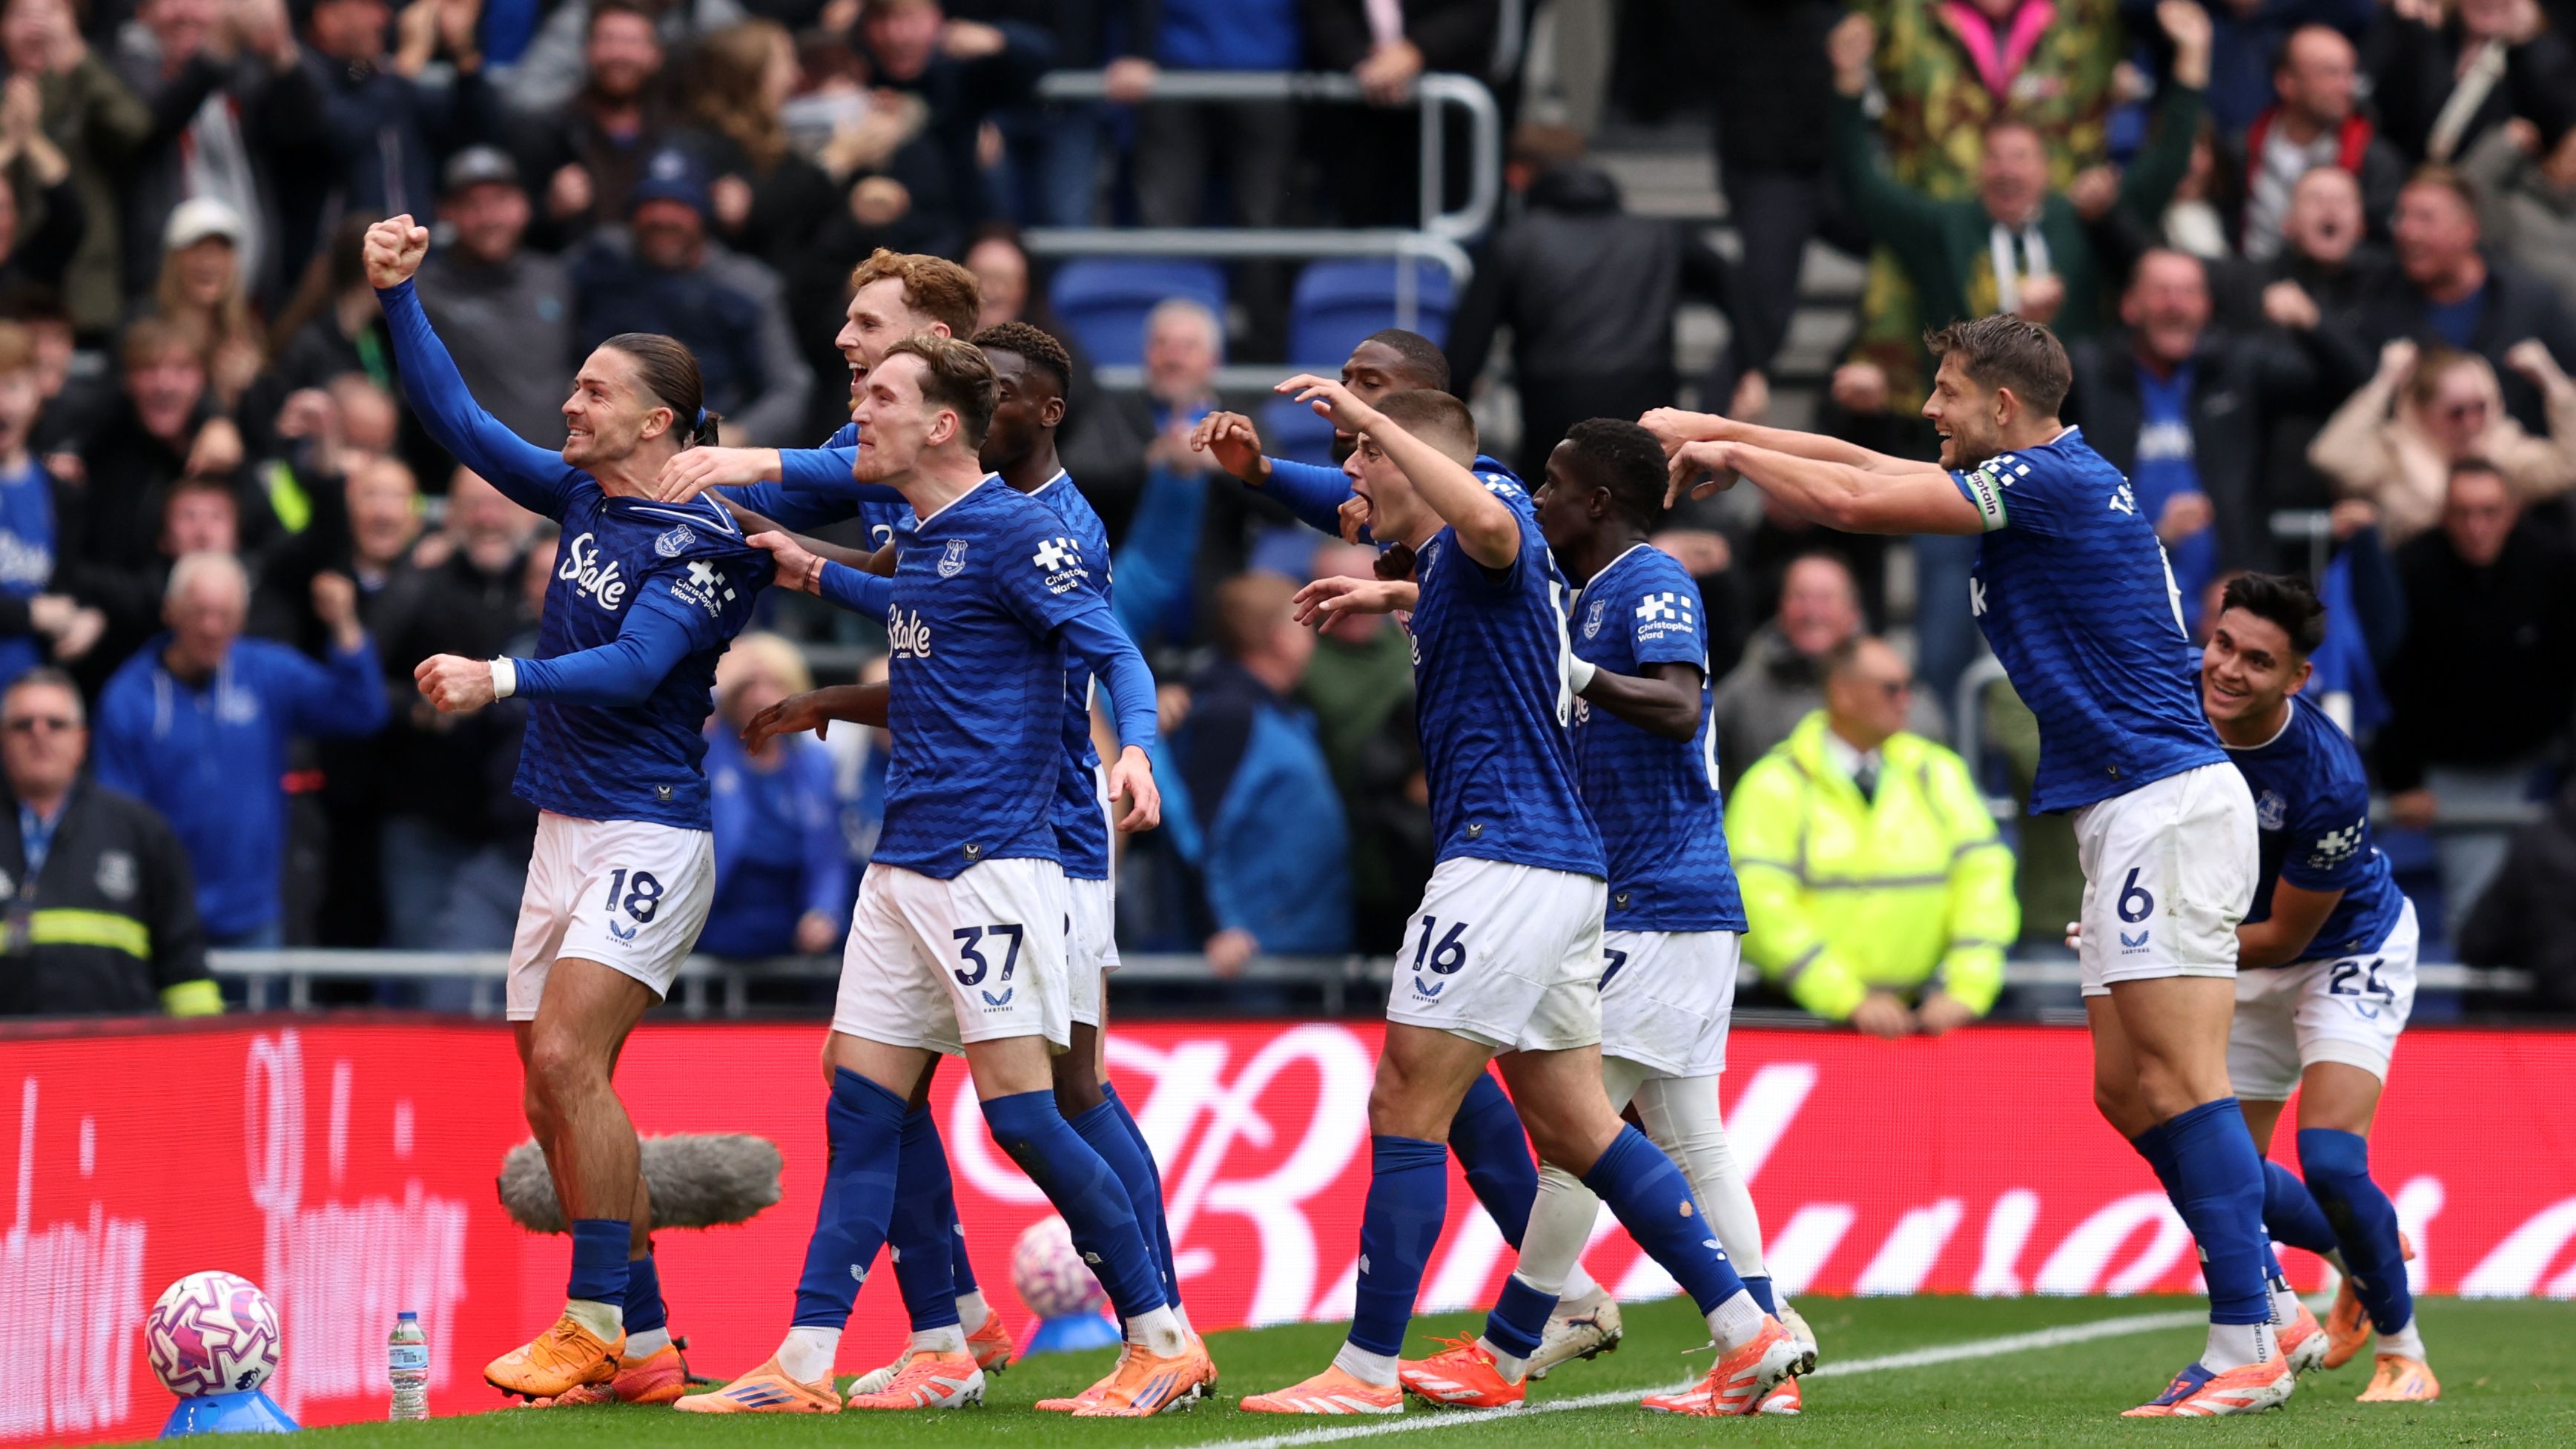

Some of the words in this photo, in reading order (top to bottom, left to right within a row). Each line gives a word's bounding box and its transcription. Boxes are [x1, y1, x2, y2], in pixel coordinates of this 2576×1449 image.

[559, 532, 626, 610] Stake
[670, 585, 696, 605] Ward
[1050, 579, 1078, 595] Ward
[676, 578, 719, 618] Christopher
[1637, 621, 1694, 634] Christopher
[1637, 630, 1664, 642] Ward
[605, 868, 664, 923] 18
[2117, 867, 2154, 923] 6
[953, 923, 1023, 986] 37
[1412, 915, 1469, 974] 16
[2330, 957, 2395, 1006] 24
